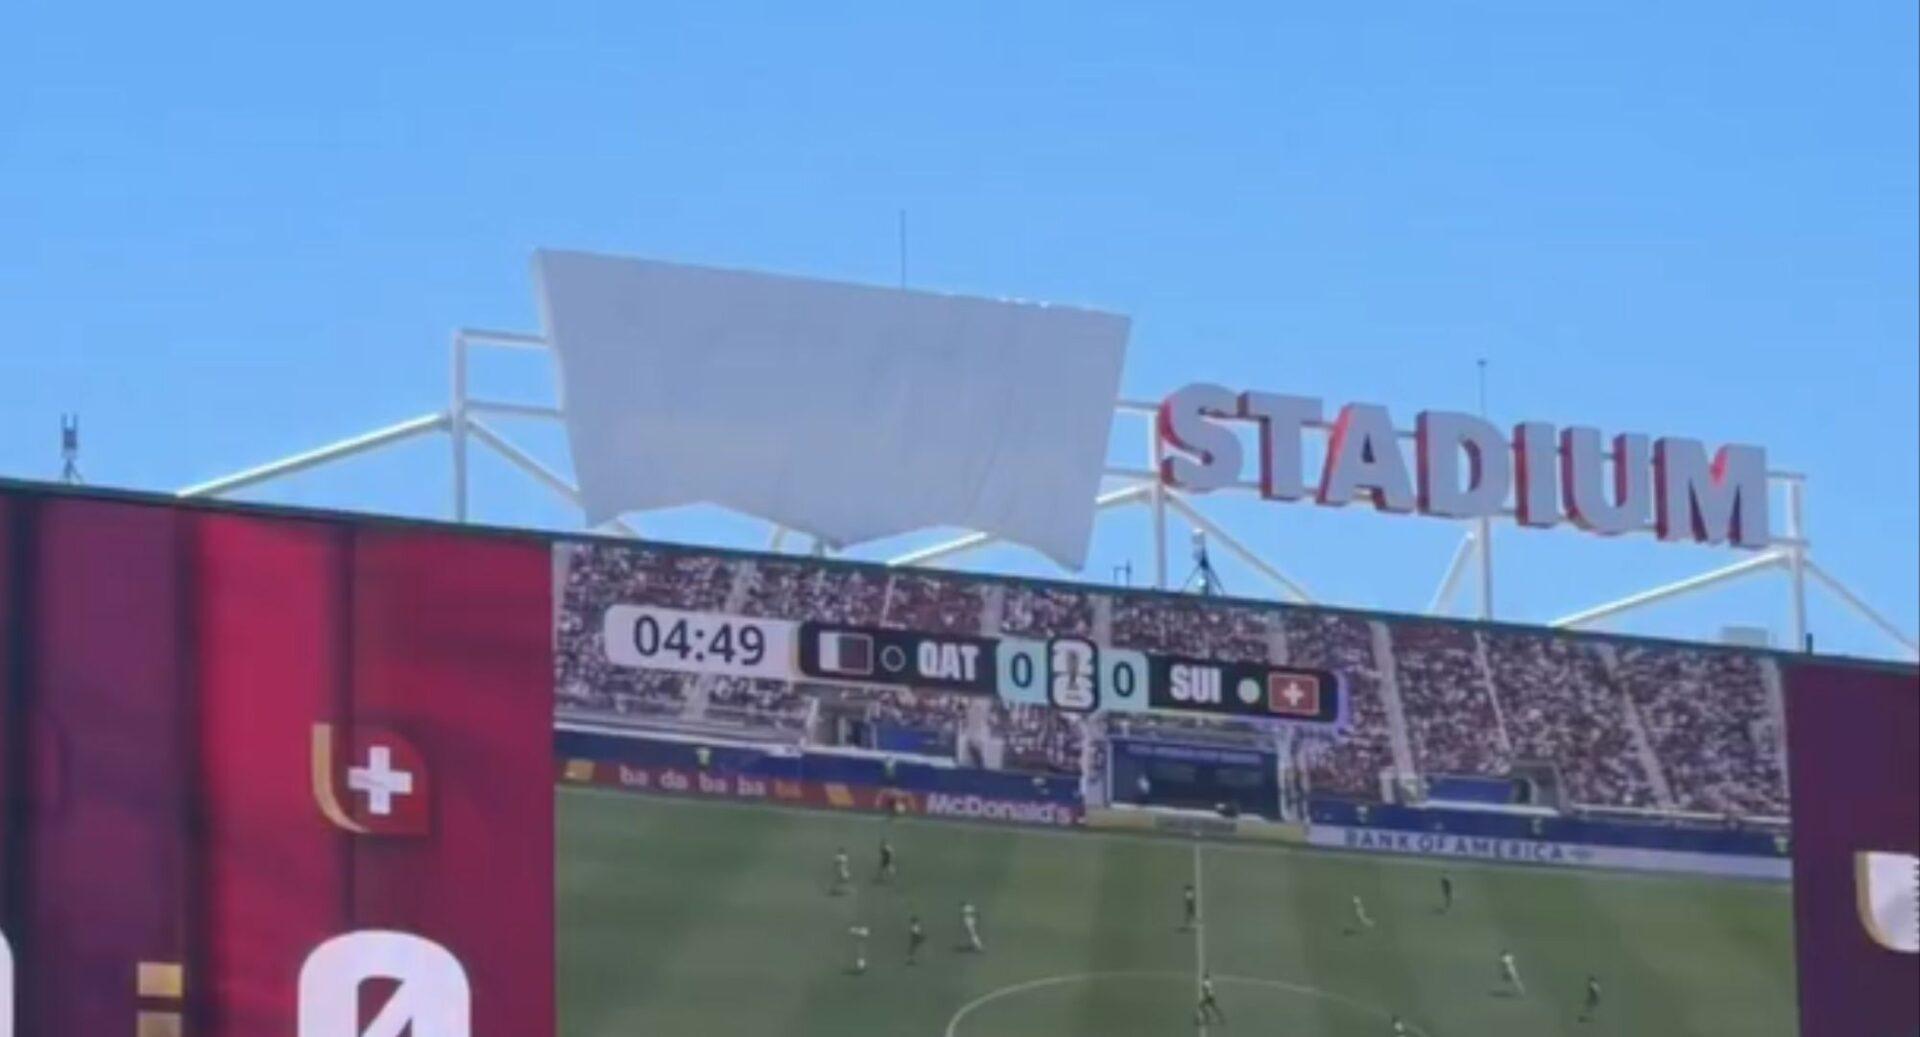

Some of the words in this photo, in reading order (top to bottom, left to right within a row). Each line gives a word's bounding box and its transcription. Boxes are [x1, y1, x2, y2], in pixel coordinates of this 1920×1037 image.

[1158, 382, 1768, 548] STADIUM
[634, 614, 765, 666] 04:49
[917, 641, 980, 681] QAT
[1010, 652, 1033, 688] 0
[1112, 661, 1136, 697] 0
[1169, 663, 1222, 703] SUI
[926, 792, 1074, 825] McDonald's
[1343, 826, 1408, 849] BANK
